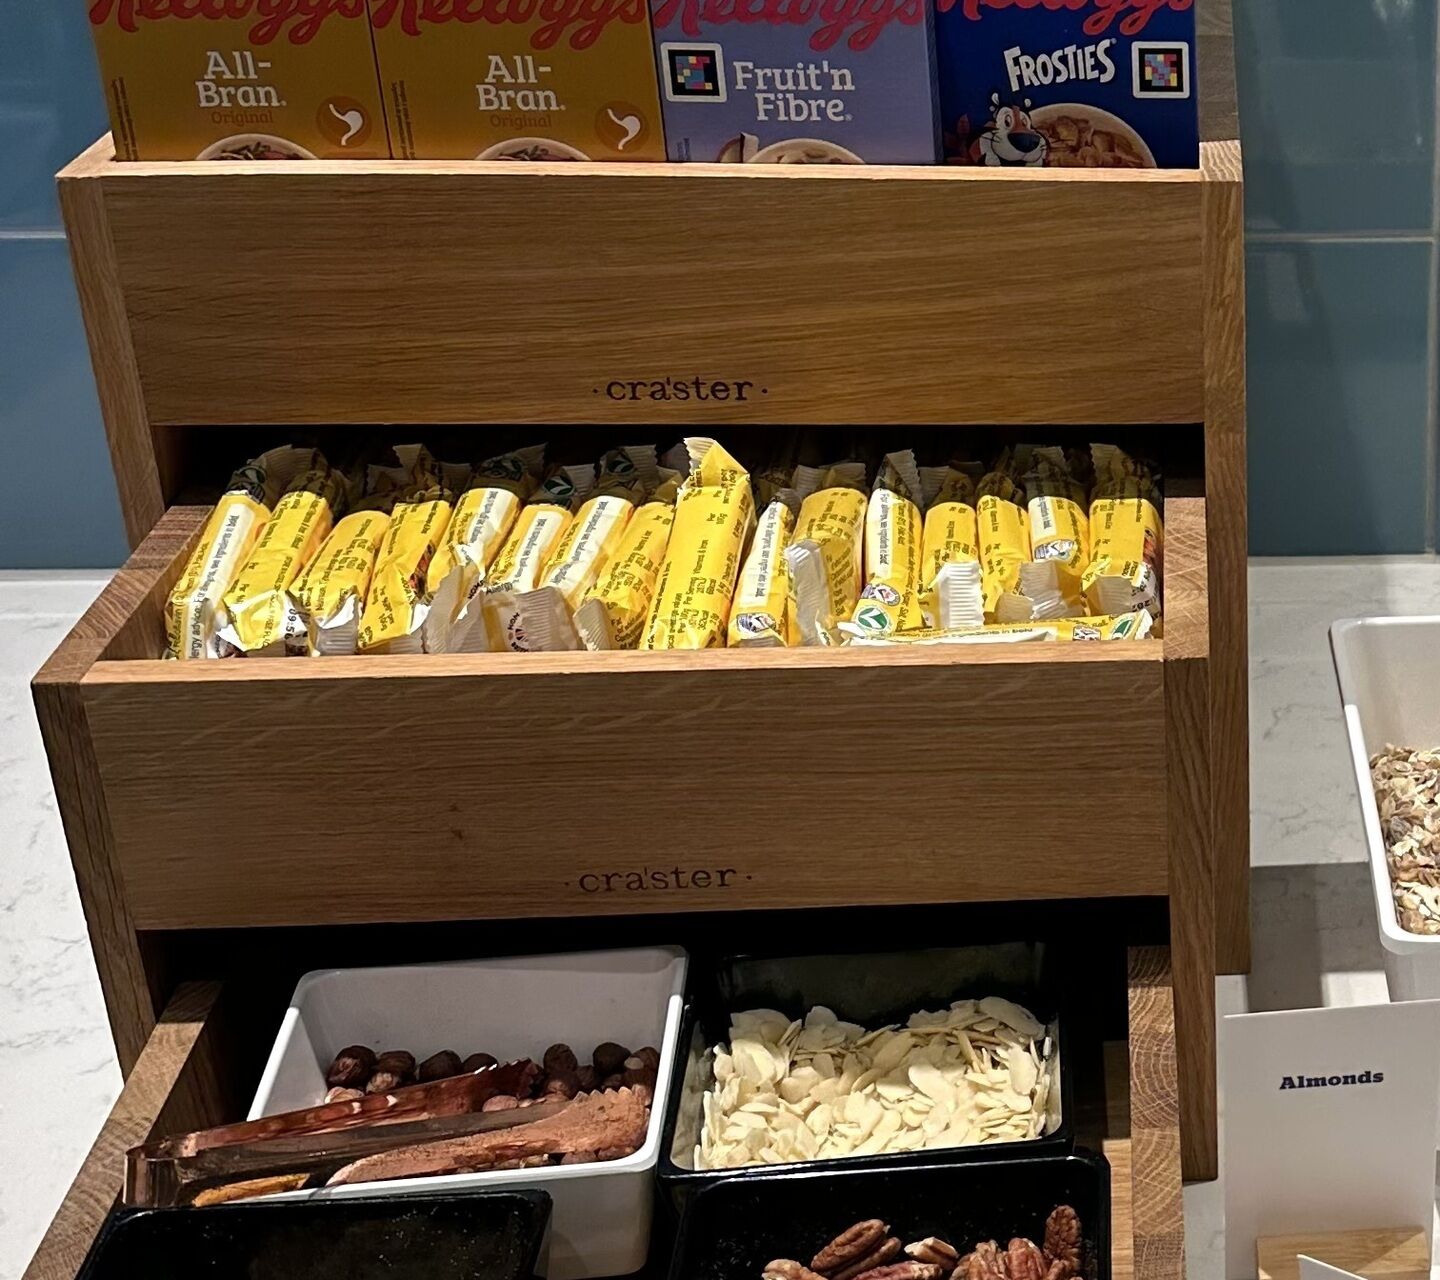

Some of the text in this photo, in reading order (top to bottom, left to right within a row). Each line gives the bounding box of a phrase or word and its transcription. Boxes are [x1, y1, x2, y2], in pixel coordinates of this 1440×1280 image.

[203, 50, 272, 80] All-
[484, 55, 552, 84] All-
[732, 60, 856, 92] Fruit'n
[210, 110, 275, 127] Original
[490, 113, 553, 131] Original
[1279, 1070, 1385, 1091] Almonds
